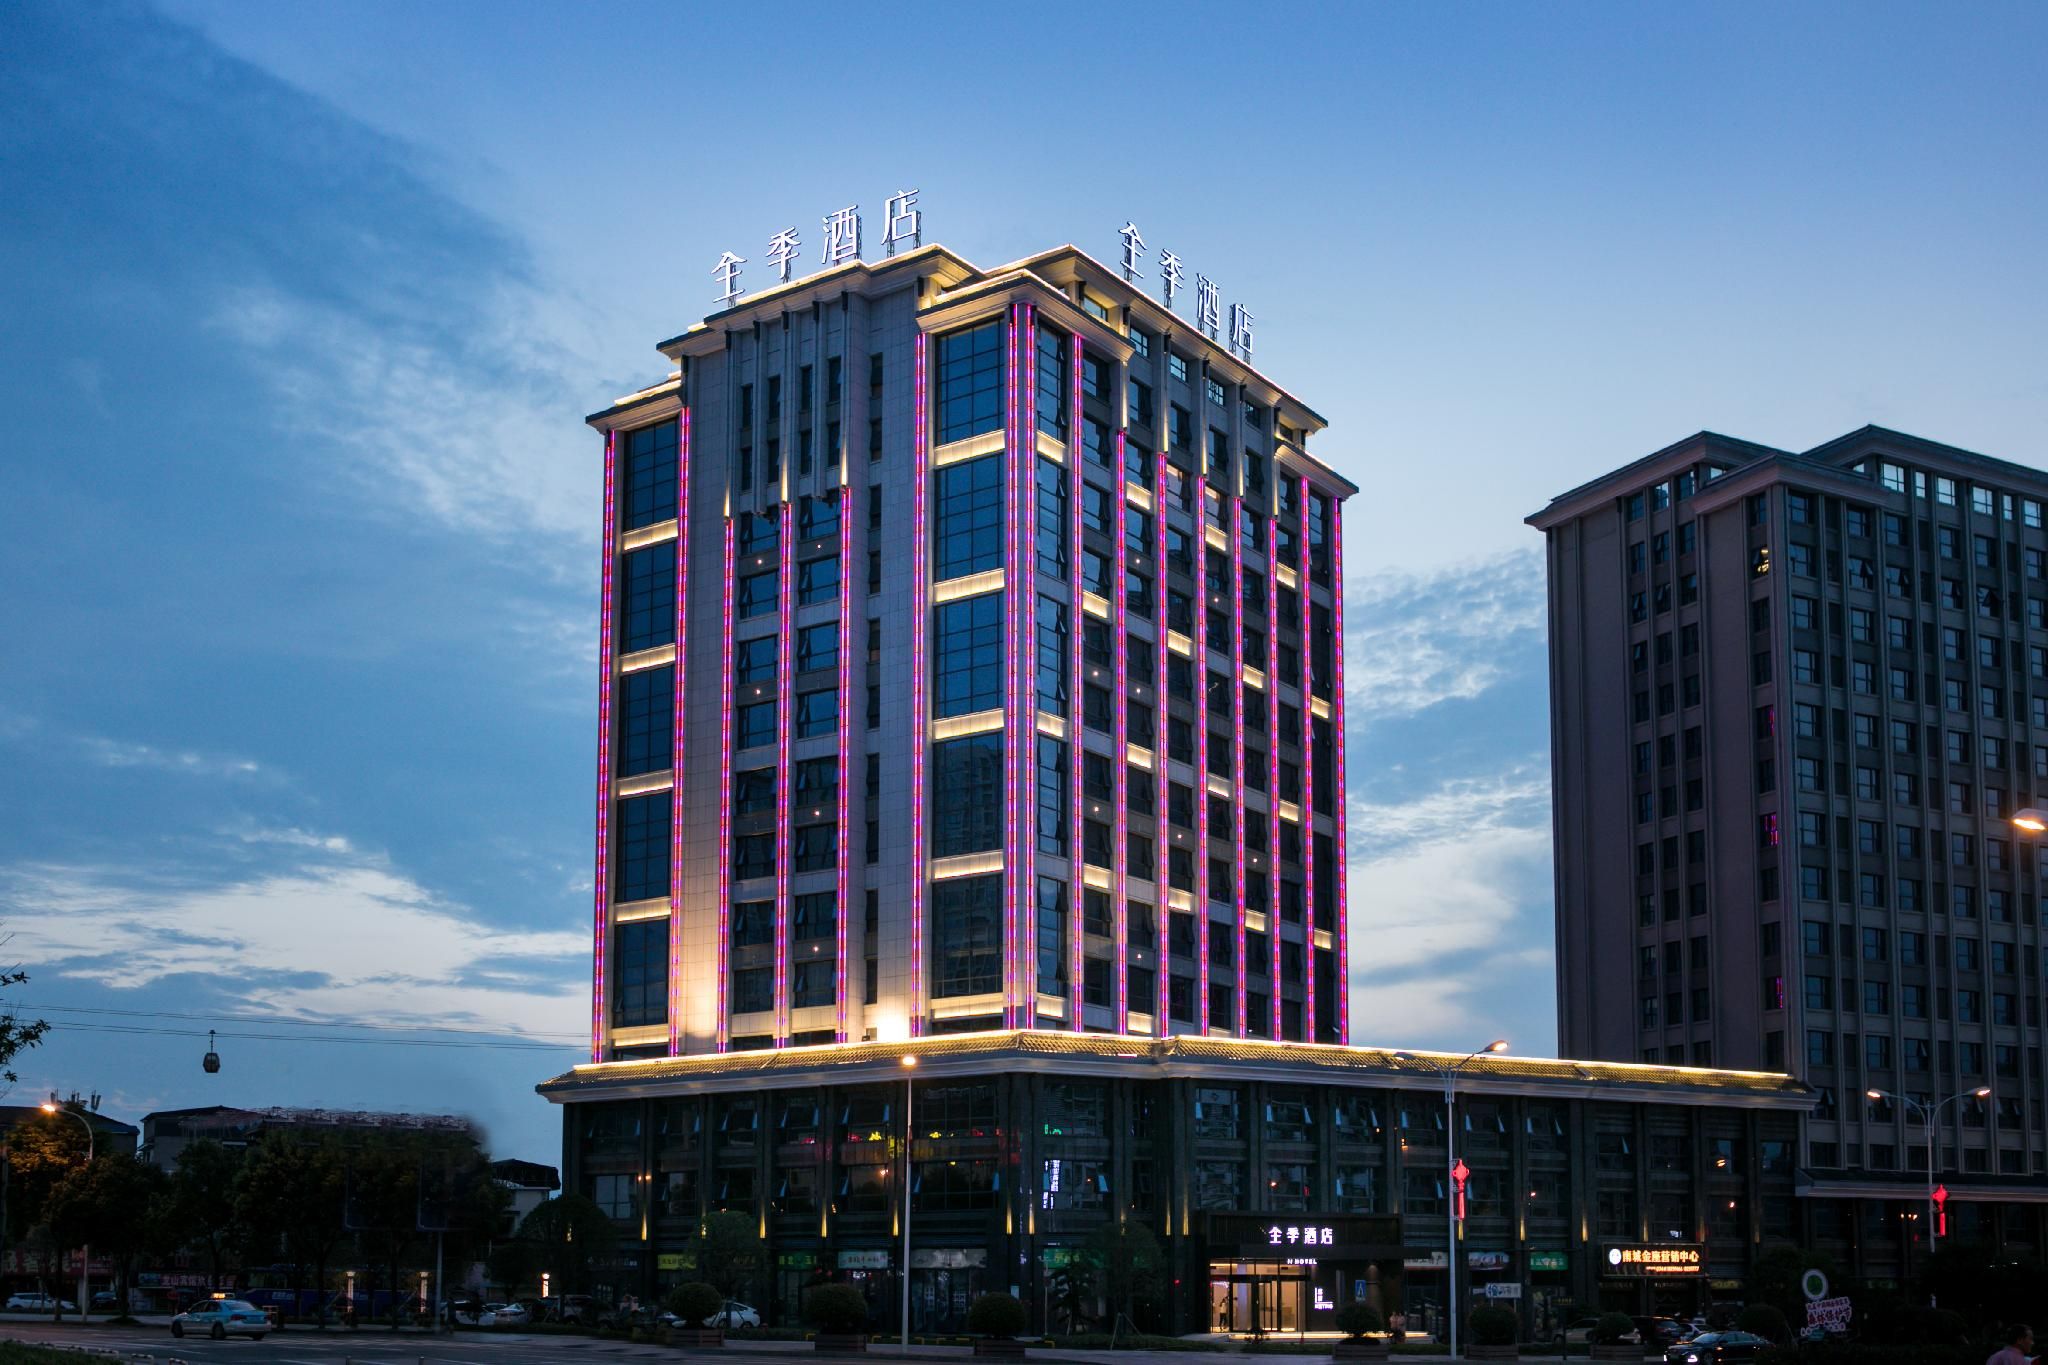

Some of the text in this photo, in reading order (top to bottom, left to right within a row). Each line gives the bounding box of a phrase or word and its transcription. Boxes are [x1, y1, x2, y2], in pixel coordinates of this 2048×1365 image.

[711, 188, 920, 303] 全季酒店
[1118, 221, 1254, 353] 全季酒店
[1268, 1226, 1334, 1245] 全季酒店
[1622, 1249, 1699, 1263] 南城金座营销中心
